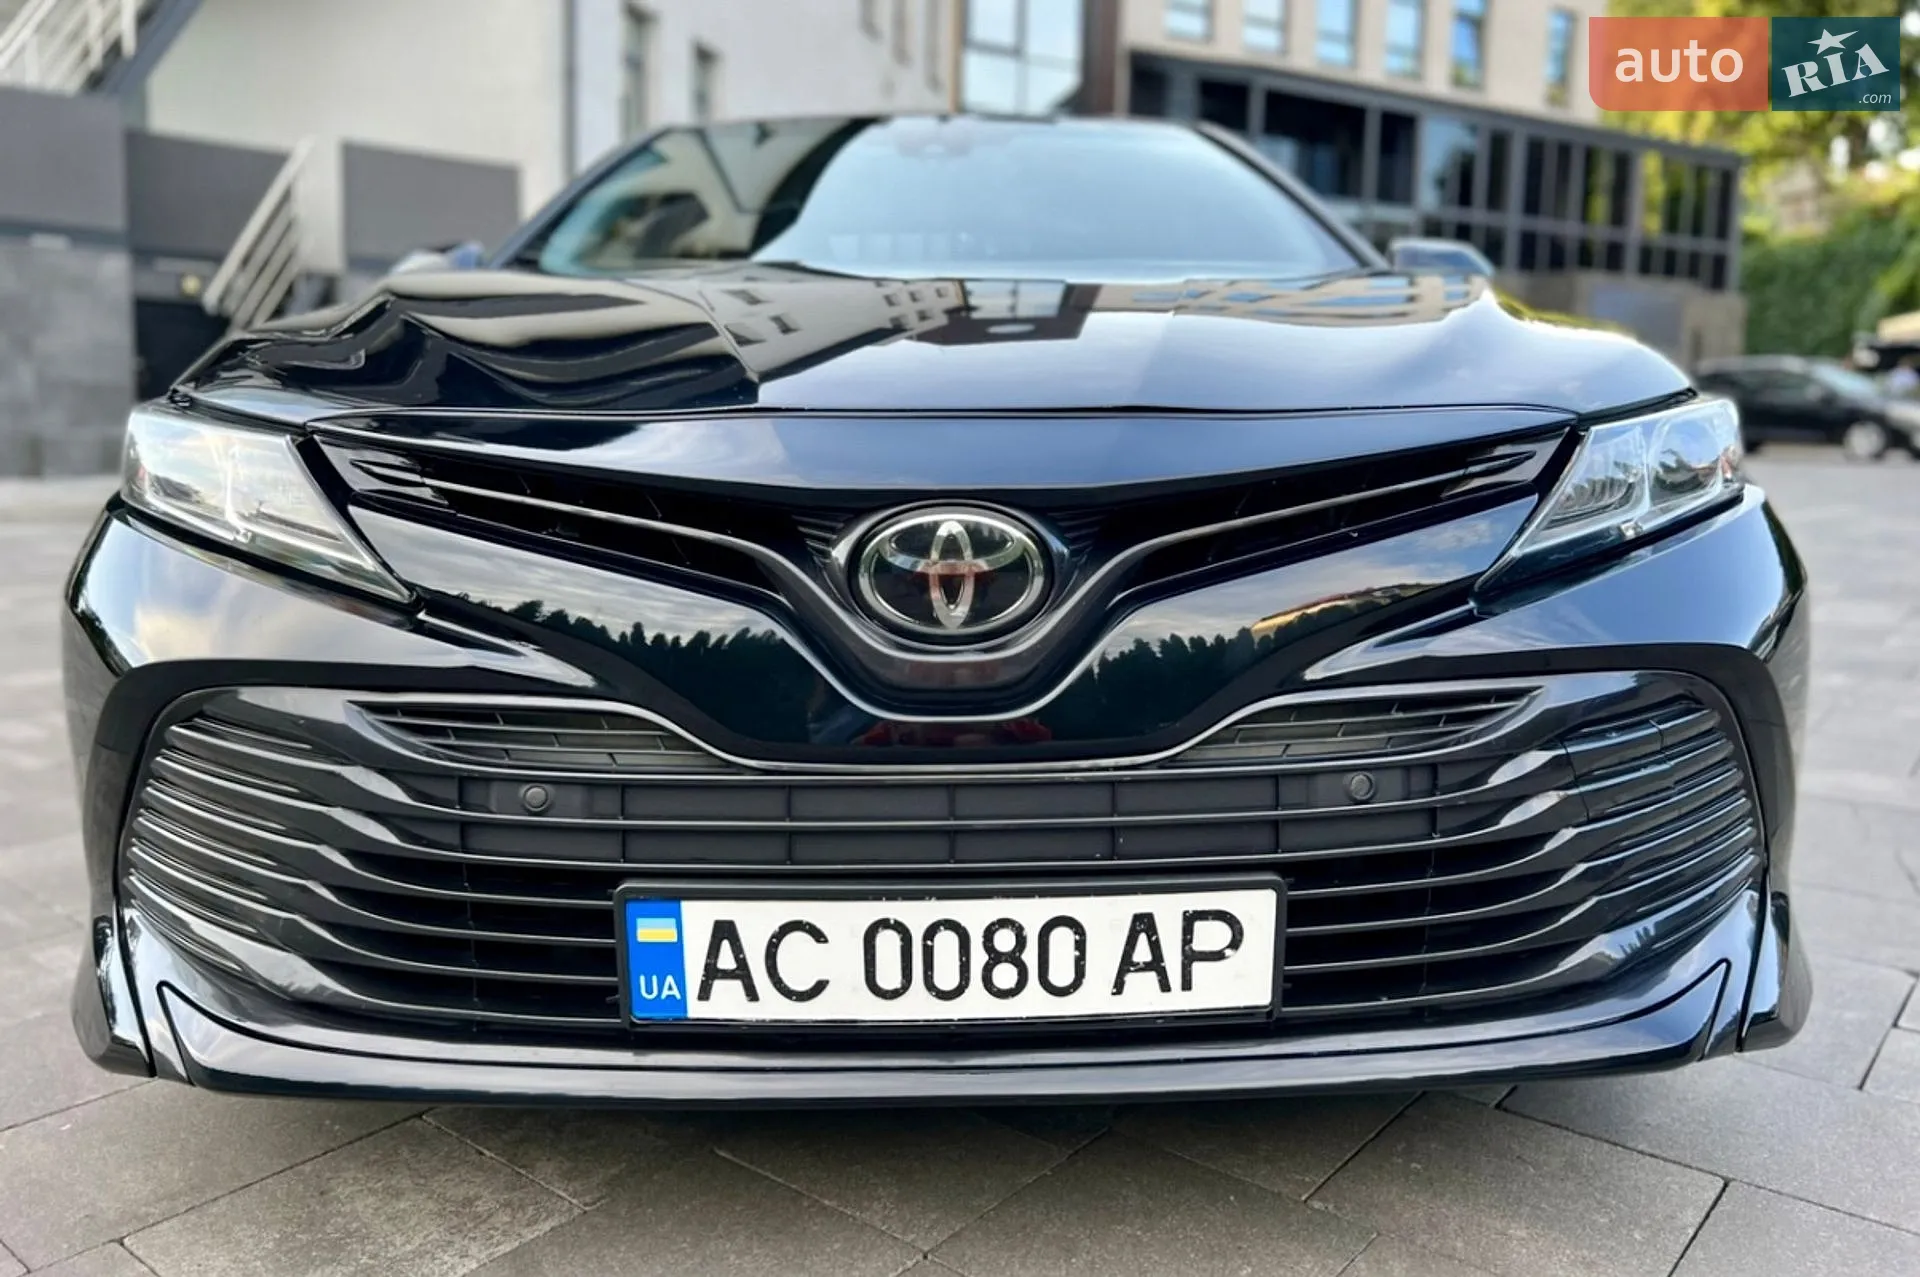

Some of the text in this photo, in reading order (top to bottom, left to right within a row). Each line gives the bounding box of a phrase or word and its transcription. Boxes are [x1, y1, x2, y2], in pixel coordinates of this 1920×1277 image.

[697, 909, 1245, 1002] AC 0080 AP
[640, 976, 682, 1000] UA
